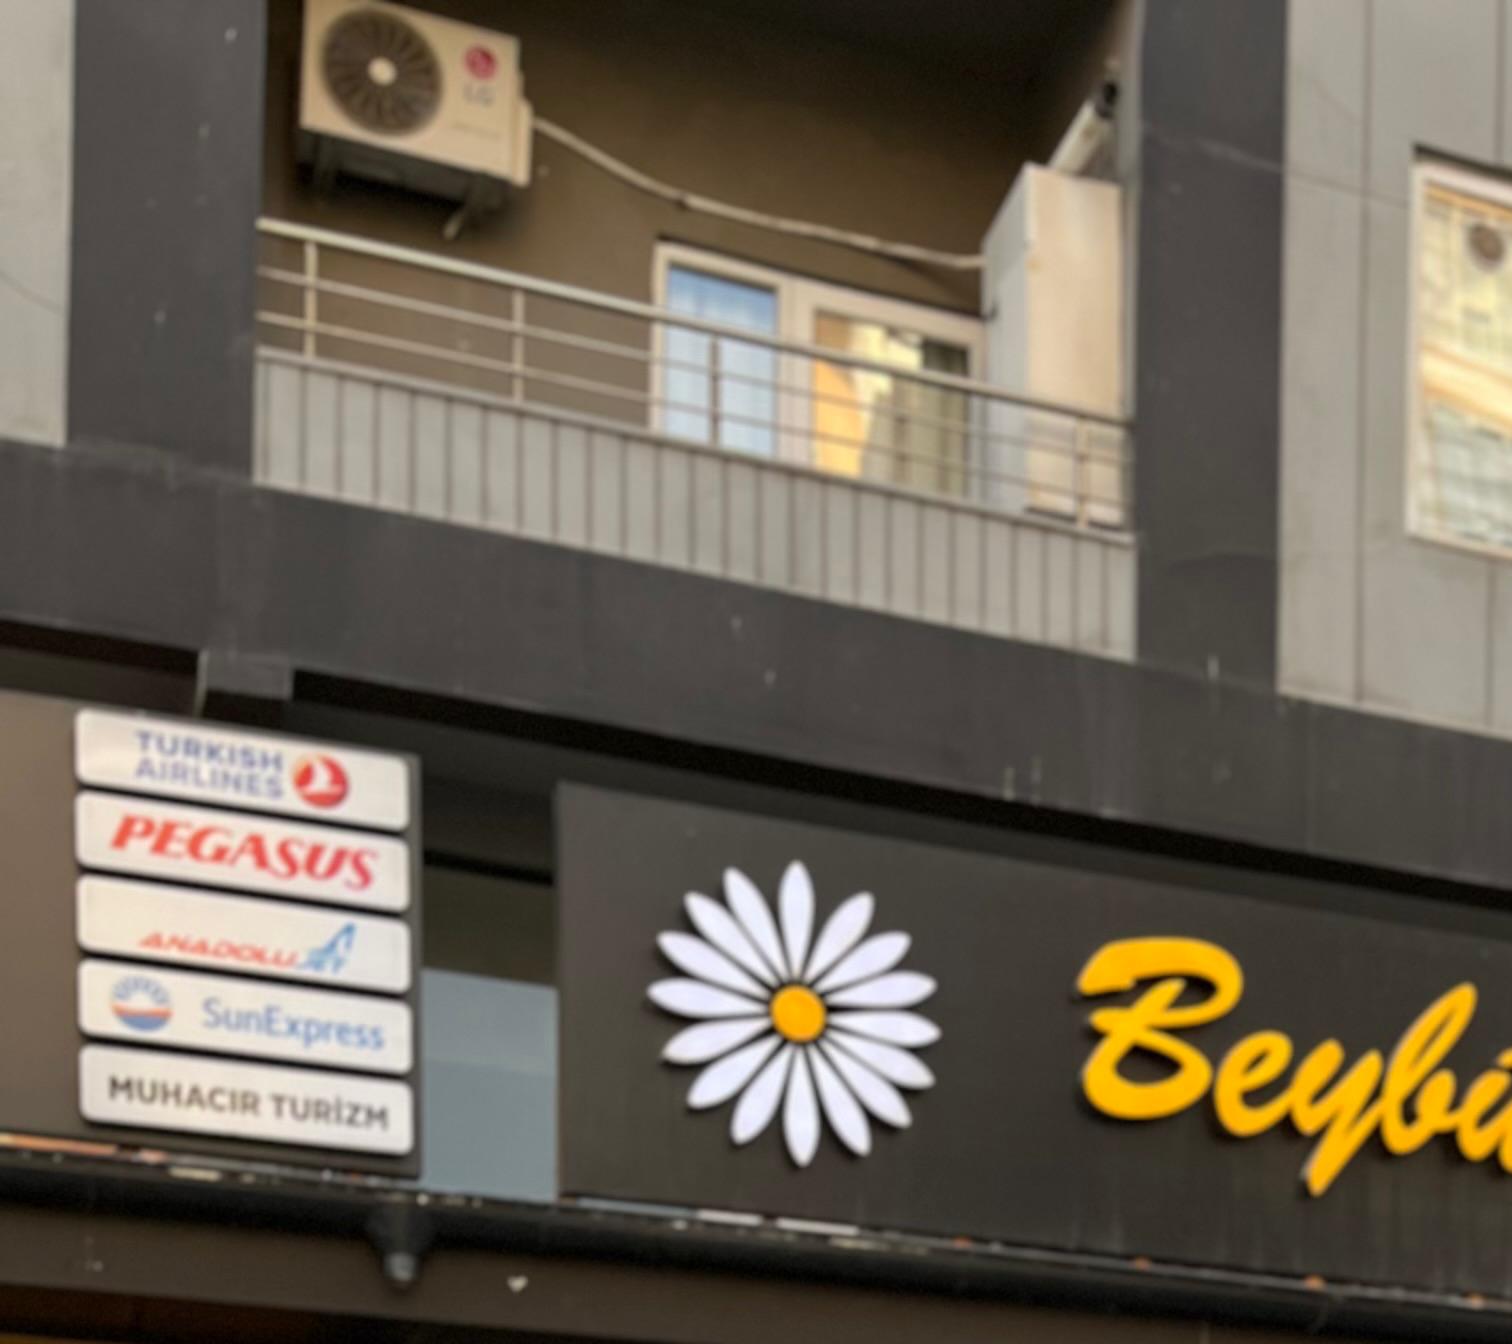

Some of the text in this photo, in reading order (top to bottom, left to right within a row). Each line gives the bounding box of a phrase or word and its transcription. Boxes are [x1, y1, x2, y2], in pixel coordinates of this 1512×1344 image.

[135, 729, 283, 771] TURKISH
[135, 757, 283, 800] AIRLINES
[110, 813, 378, 891] PEGASUS
[202, 996, 385, 1050] SunExpress
